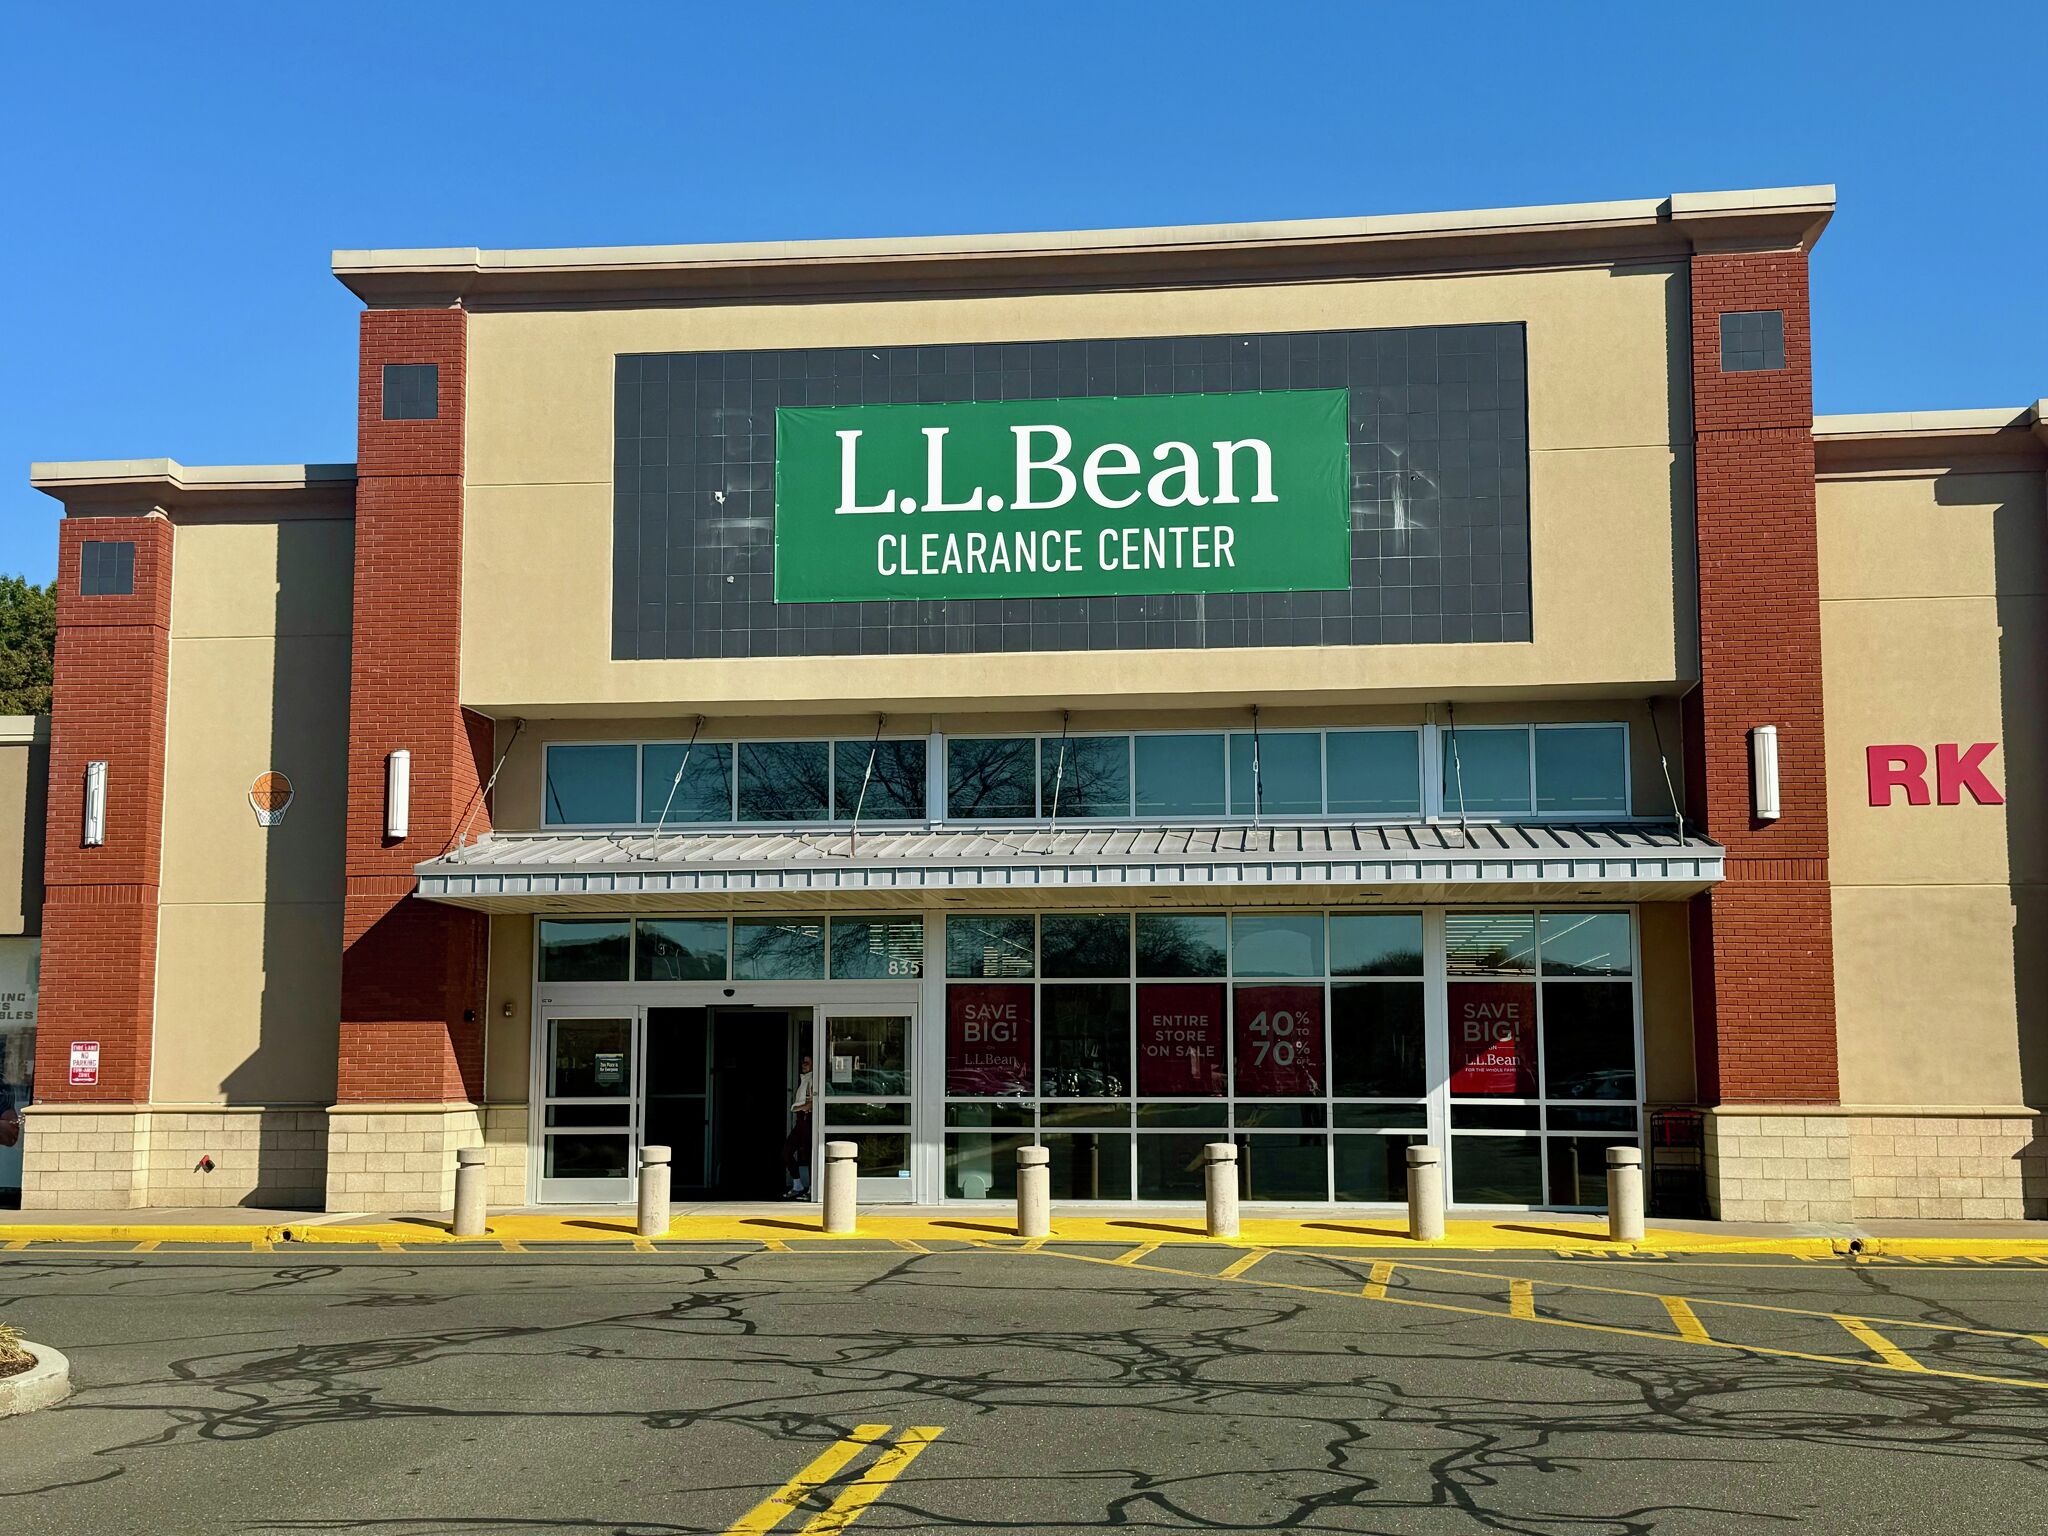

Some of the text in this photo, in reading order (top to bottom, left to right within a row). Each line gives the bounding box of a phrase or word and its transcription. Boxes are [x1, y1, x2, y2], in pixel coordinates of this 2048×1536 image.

[833, 424, 1279, 516] L.L.Bean
[876, 525, 1236, 577] CLEARANCE CENTER
[1866, 742, 2005, 806] RK
[888, 960, 920, 975] 835
[965, 1003, 1017, 1020] SAVE
[1463, 1003, 1520, 1019] SAVE
[1152, 1015, 1209, 1027] ENTIRE
[964, 1021, 1017, 1042] BIG!
[1155, 1030, 1206, 1042] STORE
[1463, 1021, 1520, 1042] BIG!
[1147, 1045, 1215, 1057] ON SALE
[1464, 1053, 1521, 1066] L.L.Bean
